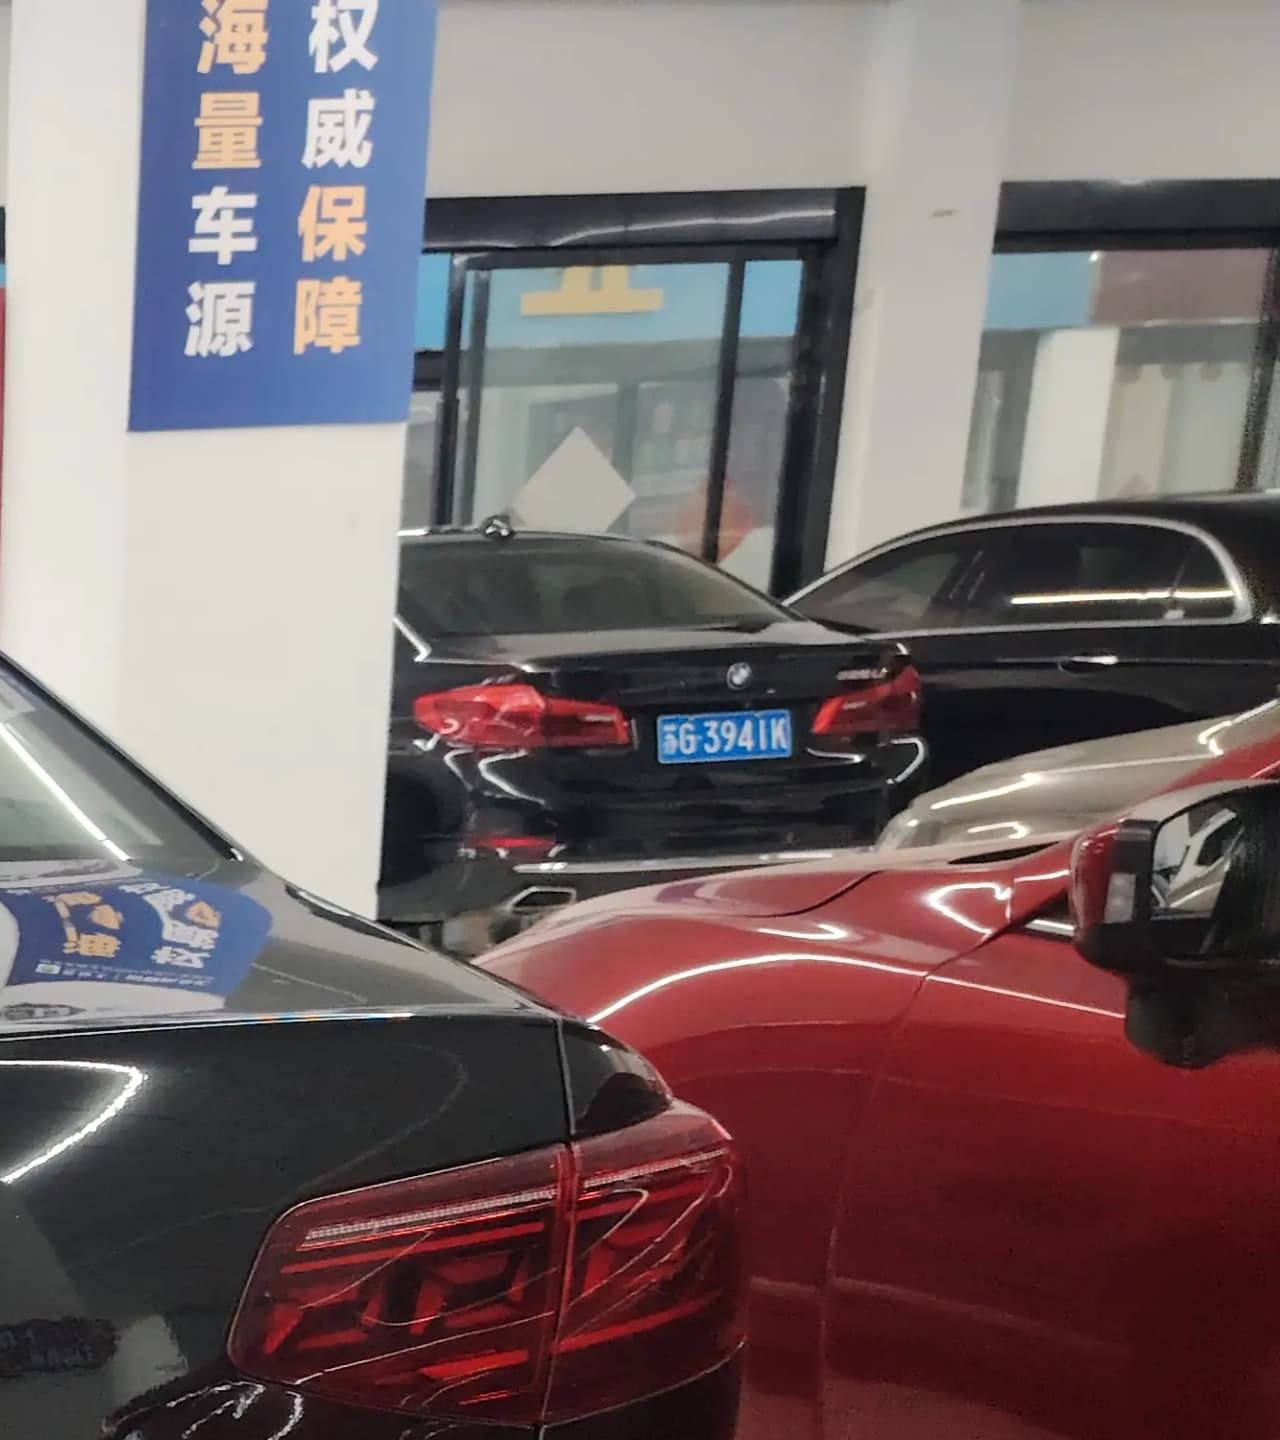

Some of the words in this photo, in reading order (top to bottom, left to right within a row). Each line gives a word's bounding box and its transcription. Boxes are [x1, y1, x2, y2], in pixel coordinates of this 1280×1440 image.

[184, 0, 270, 358] 海量车源
[293, 0, 378, 356] 权威保障
